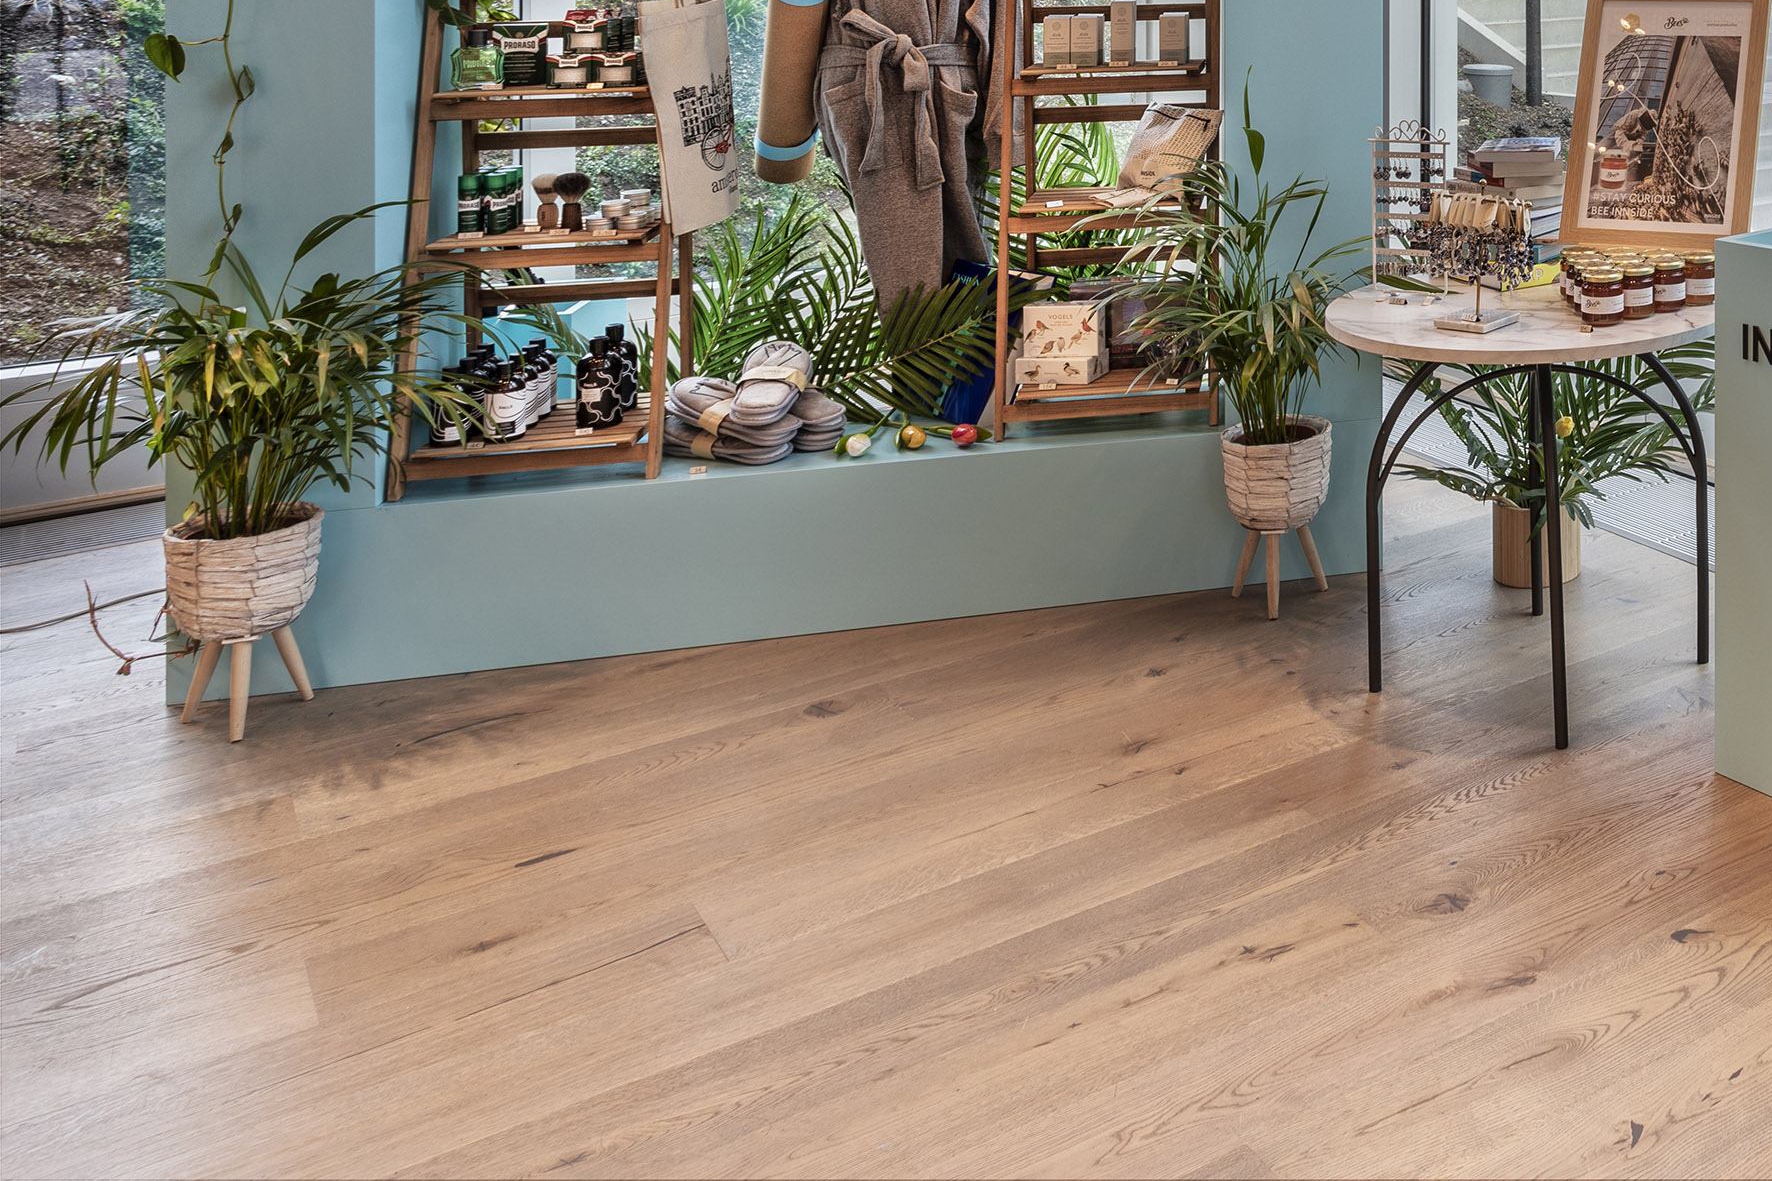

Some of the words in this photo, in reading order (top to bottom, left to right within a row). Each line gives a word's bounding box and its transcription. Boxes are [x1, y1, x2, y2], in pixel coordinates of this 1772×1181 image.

[504, 40, 536, 50] PRORASO
[1593, 193, 1627, 202] #STAY
[1628, 193, 1677, 205] CURIOUS
[1591, 206, 1610, 216] BEE
